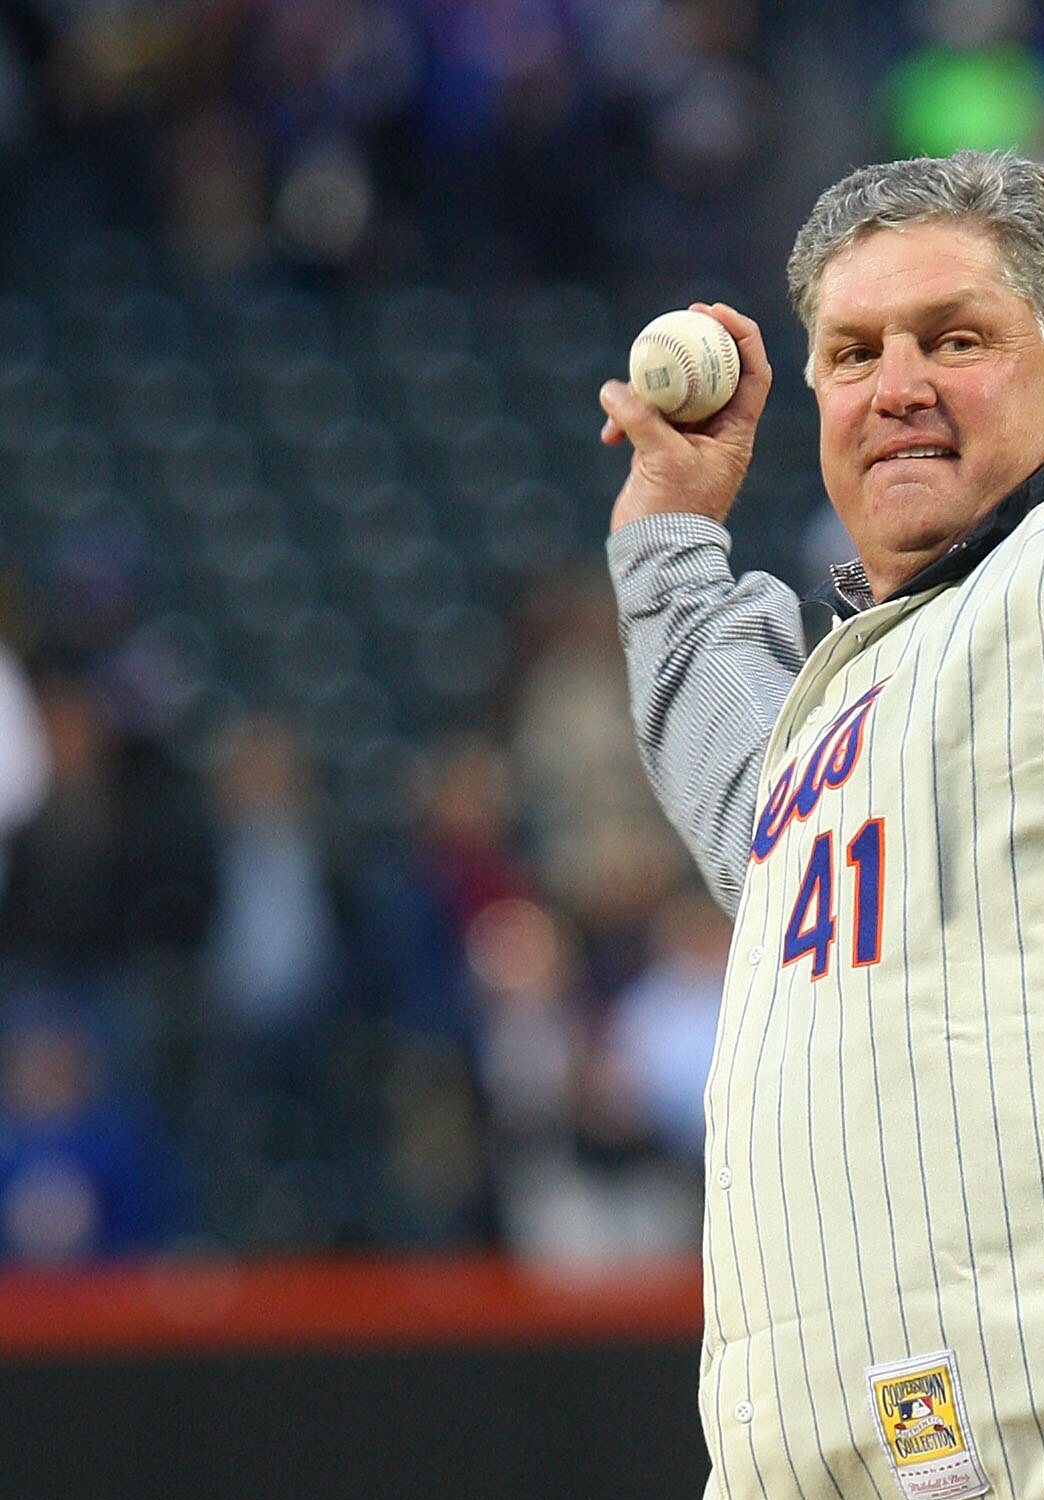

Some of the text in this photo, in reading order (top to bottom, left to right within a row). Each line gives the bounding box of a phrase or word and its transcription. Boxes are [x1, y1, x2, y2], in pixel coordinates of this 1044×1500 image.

[748, 675, 894, 863] ets
[782, 817, 885, 982] 41
[882, 1373, 946, 1417] COOPERSTOWN
[895, 1425, 957, 1458] COLLECTION
